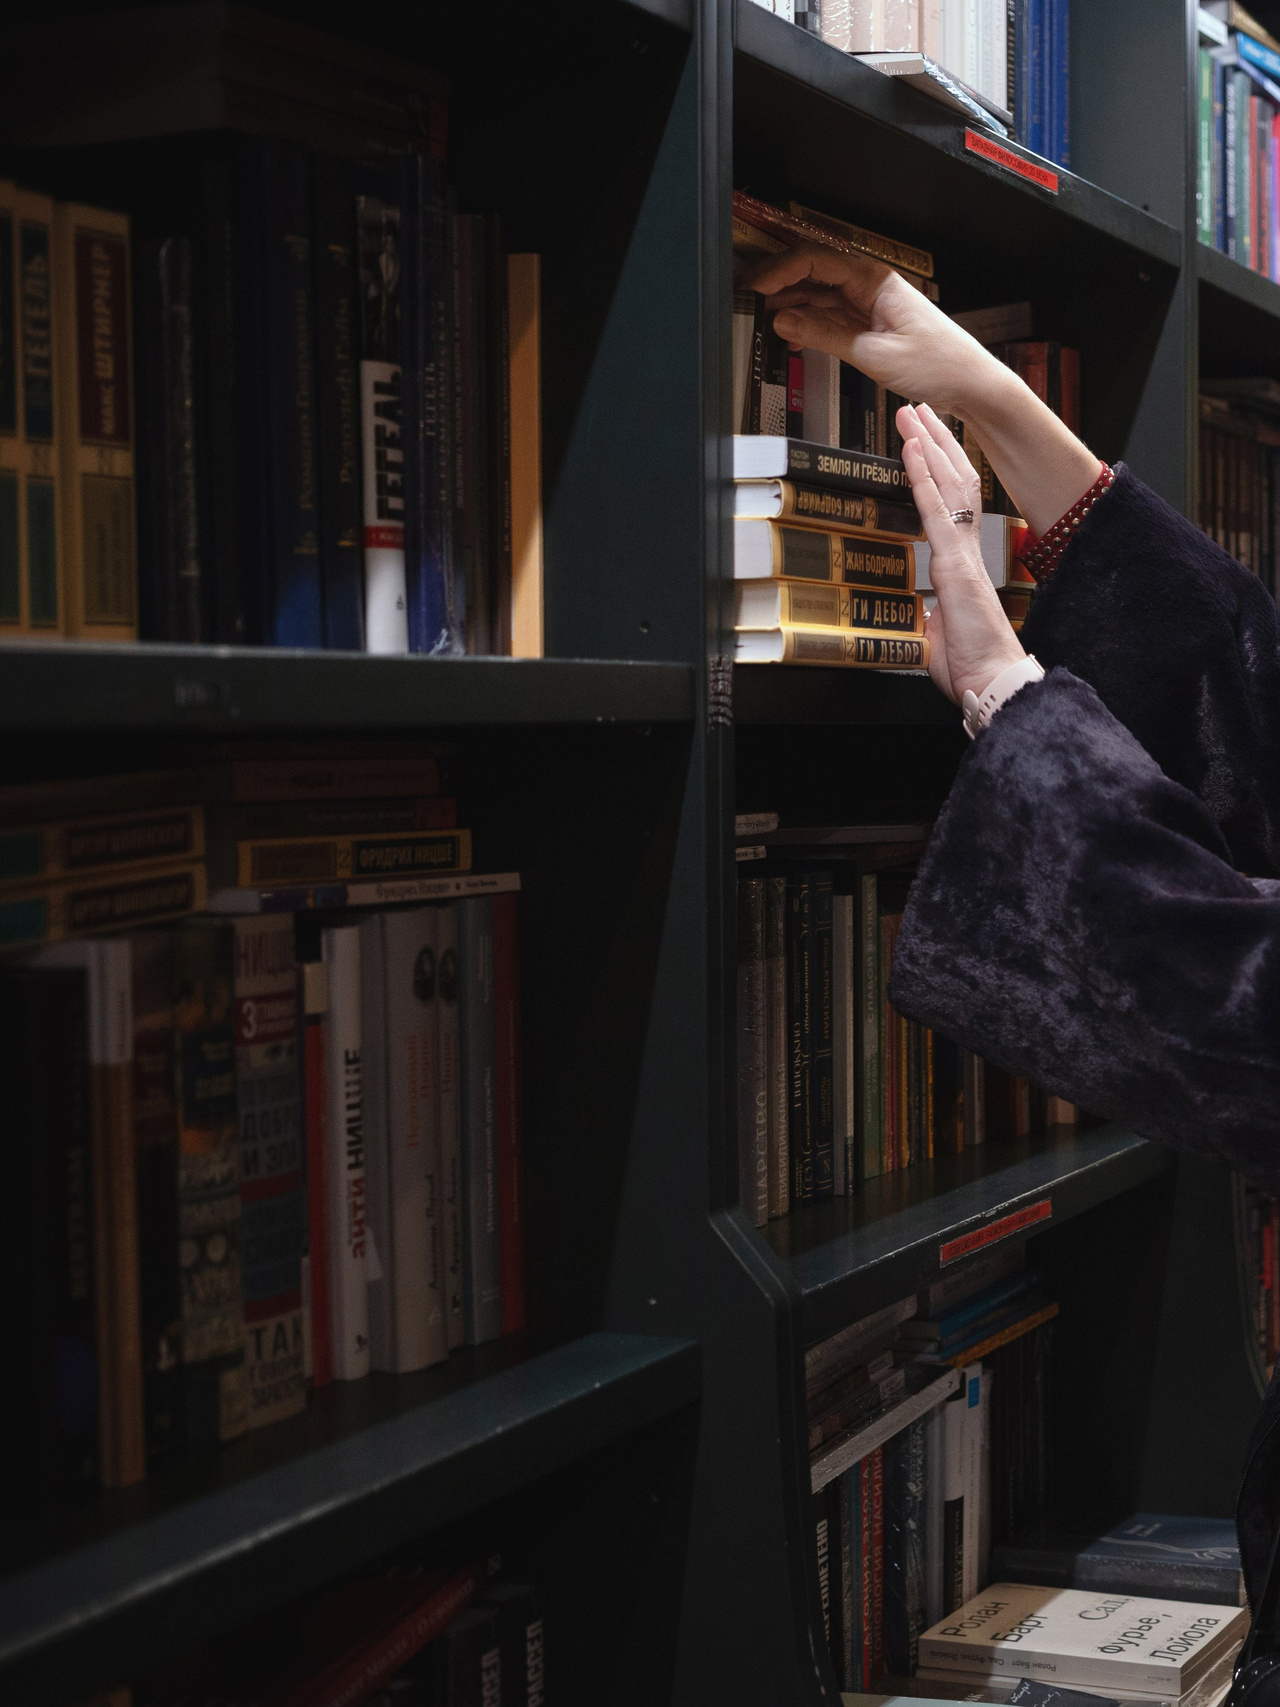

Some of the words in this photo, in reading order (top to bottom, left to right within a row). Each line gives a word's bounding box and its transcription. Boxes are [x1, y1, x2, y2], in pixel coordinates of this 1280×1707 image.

[91, 243, 115, 380] ШТИРНЕР
[753, 331, 763, 387] ЮНГ
[373, 370, 404, 521] ГЕГЕЛЬ
[817, 454, 851, 476] ЗЕМЛЯ
[852, 463, 860, 478] И
[861, 461, 891, 484] ГРЁЗЫ
[892, 470, 900, 486] О
[797, 490, 843, 517] БОДРИЙЯР
[843, 500, 863, 520] ЖАН
[845, 550, 865, 571] ЖАН
[865, 553, 905, 578] БОДРИЙЯР
[853, 597, 868, 621] ГИ
[873, 599, 914, 626] ДЕБОР
[859, 638, 875, 661] ГИ
[878, 640, 920, 663] ДЕБОР
[359, 845, 412, 869] ФРИДРИХ
[413, 843, 453, 866] НИЦШЕ
[243, 1001, 258, 1039] 3
[344, 1049, 364, 1171] НИЦШЕ
[777, 1061, 789, 1199] ЛИБИДИНАЛЬНАЯ
[754, 1090, 768, 1210] ЦАРСТВО
[350, 1177, 366, 1258] анти
[862, 1554, 870, 1646] АГОНИЯ
[873, 1544, 883, 1661] ТОПОЛОГИЯ
[939, 1600, 1010, 1638] Ролан
[1078, 1597, 1136, 1621] Сад,
[989, 1612, 1049, 1644] Барт
[1096, 1613, 1173, 1655] Фурье,
[1149, 1616, 1222, 1663] Лойола
[1011, 1659, 1031, 1669] Барт
[1033, 1662, 1057, 1673] Ролан
